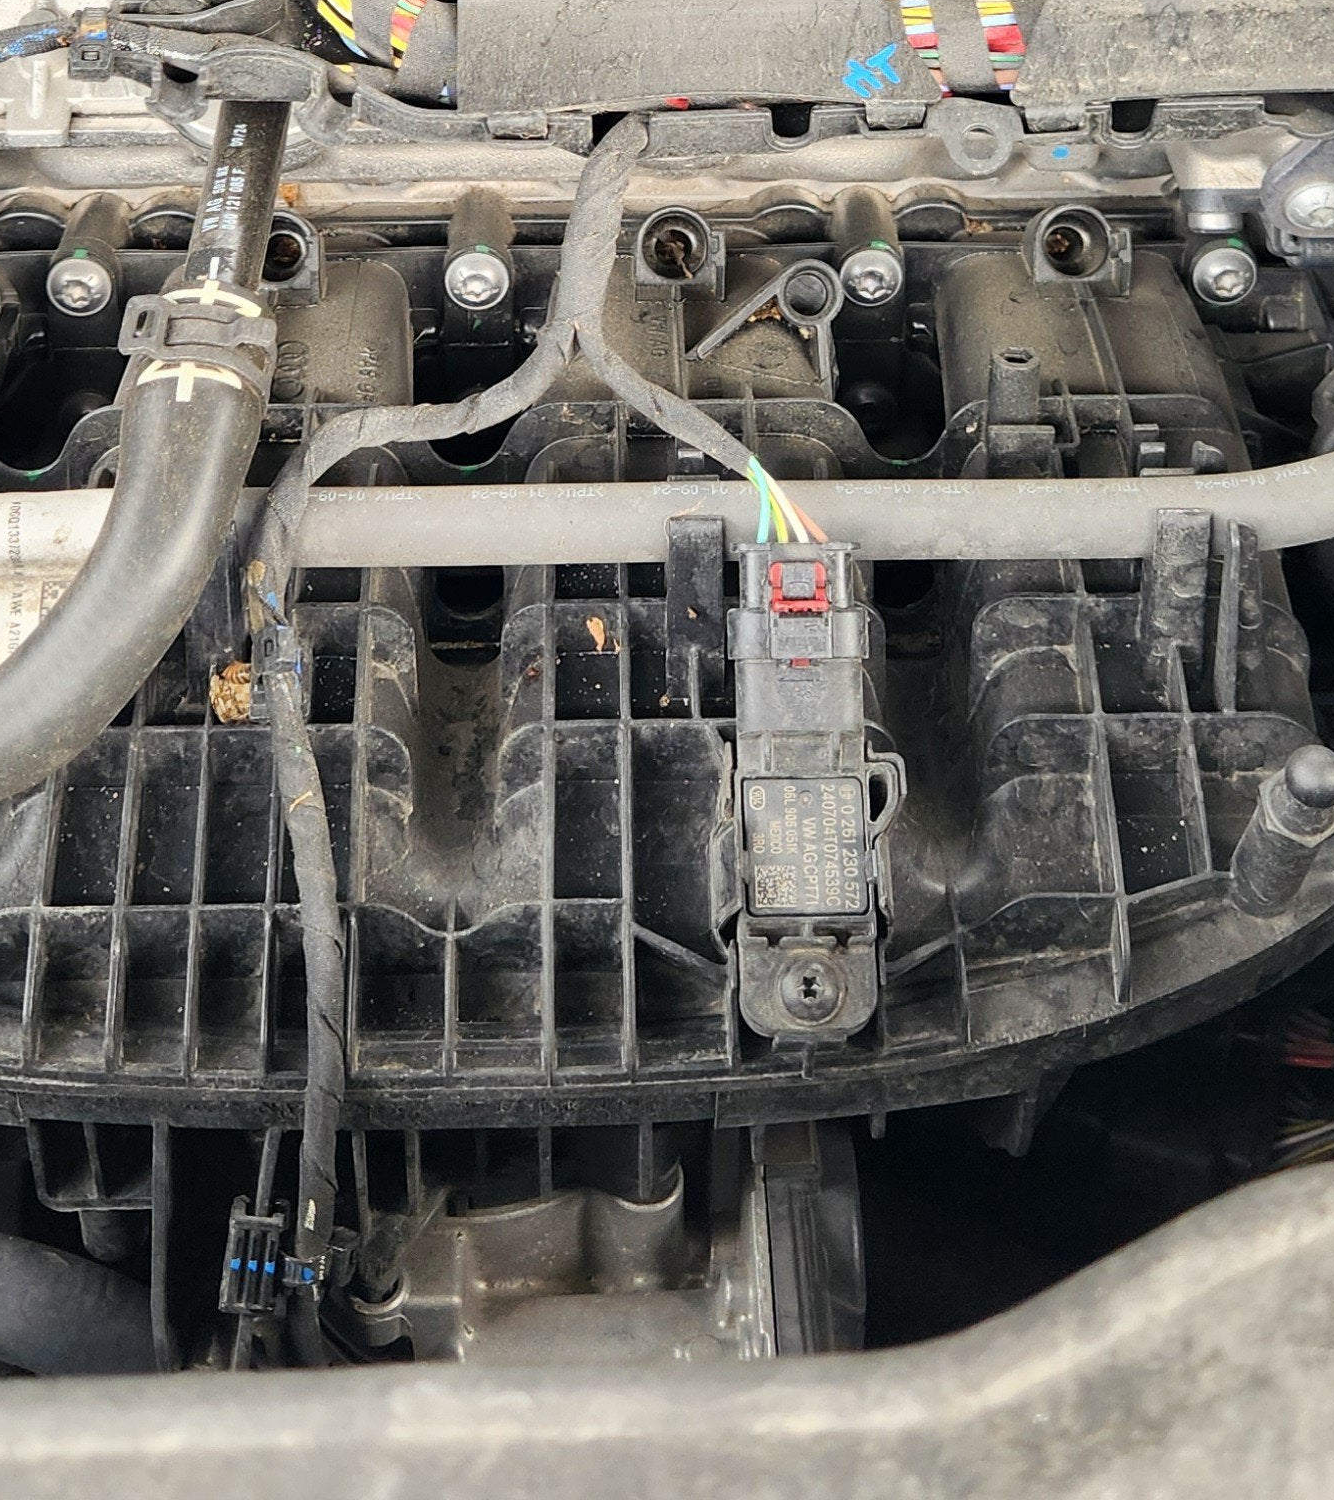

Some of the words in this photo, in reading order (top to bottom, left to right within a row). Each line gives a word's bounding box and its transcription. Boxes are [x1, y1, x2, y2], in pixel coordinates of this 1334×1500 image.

[784, 785, 795, 804] 06L
[784, 808, 796, 826] 906
[841, 805, 855, 813] 0
[769, 820, 781, 853] MEXICO
[802, 816, 816, 838] VW
[841, 818, 856, 842] 261
[786, 829, 797, 853] 051K
[803, 842, 817, 862] AG
[821, 784, 839, 906] 240704T074539C
[842, 848, 857, 876] 230
[844, 881, 859, 908] 572
